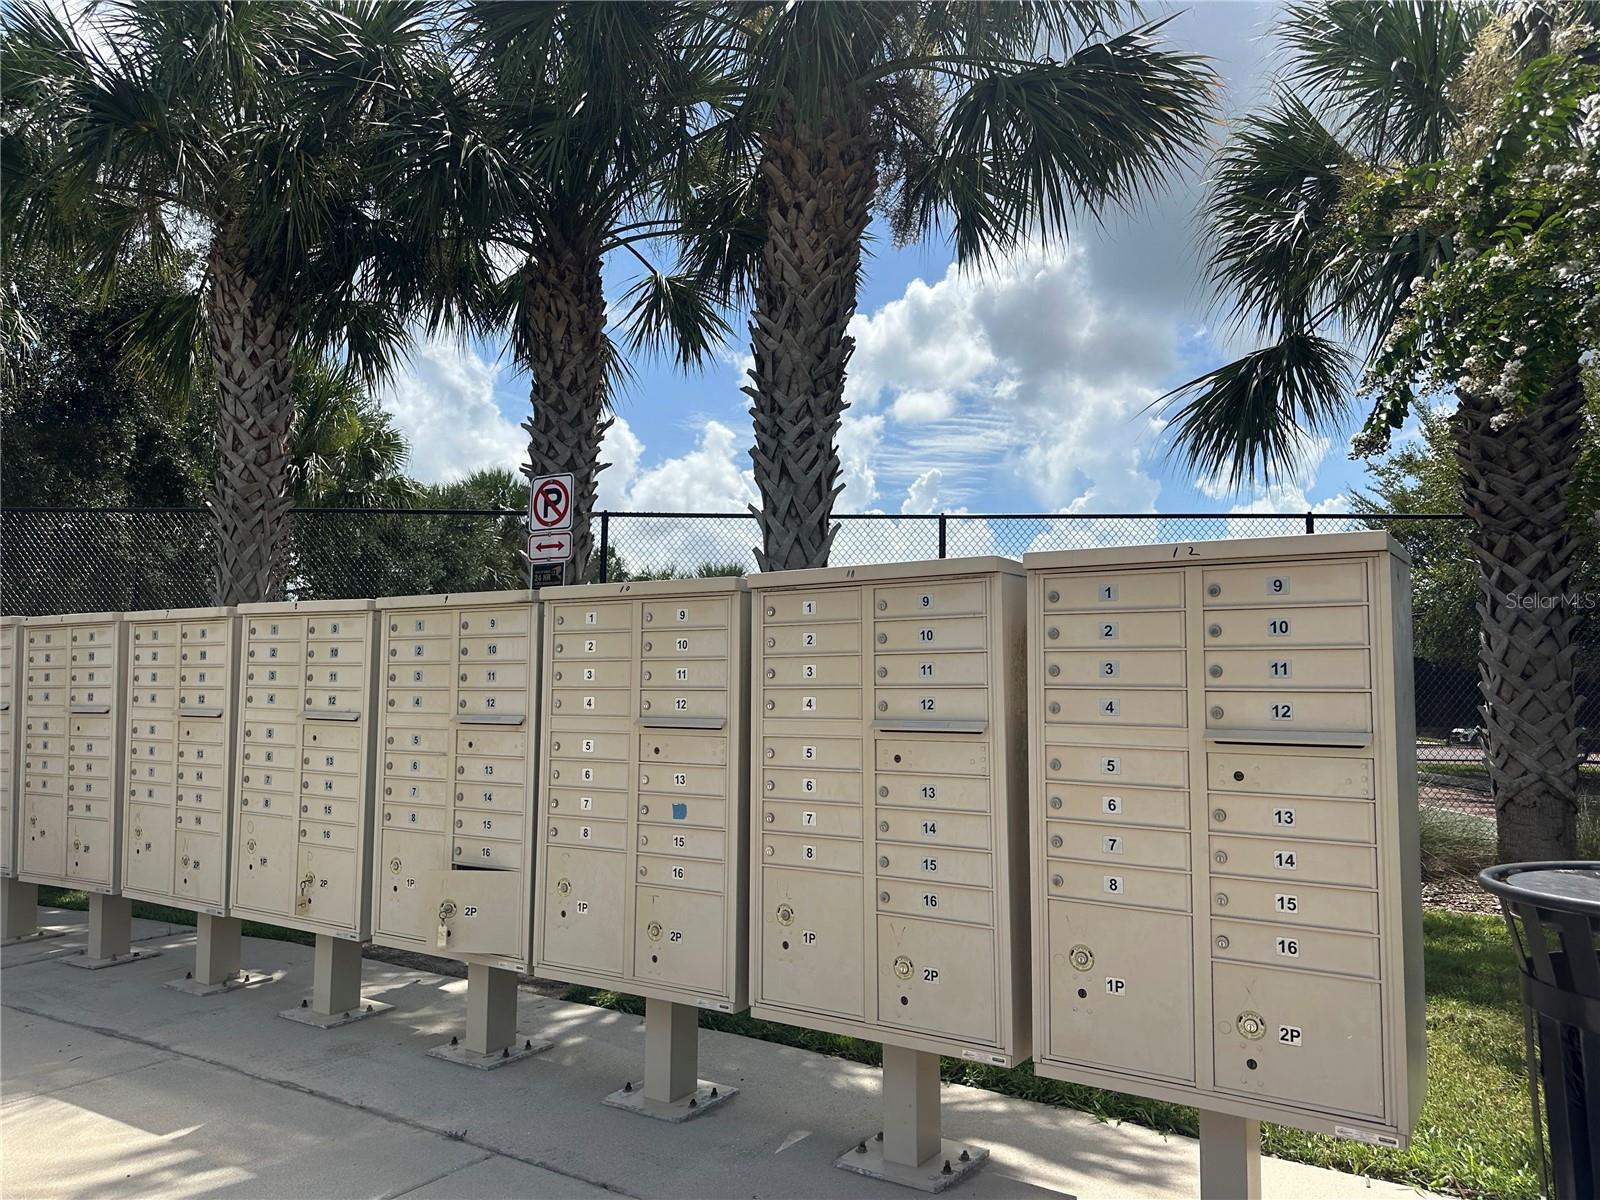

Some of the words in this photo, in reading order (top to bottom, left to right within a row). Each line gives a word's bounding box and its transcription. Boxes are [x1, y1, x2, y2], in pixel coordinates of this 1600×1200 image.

[1273, 579, 1283, 593] 9
[1104, 586, 1111, 599] 1
[922, 596, 930, 607] 9
[807, 602, 812, 613] 1
[589, 614, 594, 622] 1
[679, 610, 686, 620] 9
[1104, 624, 1113, 637] 2
[1269, 620, 1289, 634] 10
[806, 634, 813, 645] 2
[920, 630, 934, 641] 10
[488, 645, 497, 654] 10
[588, 642, 594, 651] 2
[677, 639, 688, 650] 10
[677, 669, 686, 679] 11
[806, 666, 813, 677] 3
[920, 664, 932, 676] 11
[1105, 662, 1114, 675] 3
[1271, 662, 1288, 676] 11
[487, 672, 495, 681] 11
[587, 670, 592, 680] 3
[486, 698, 495, 708] 12
[586, 698, 592, 707] 4
[676, 699, 687, 710] 12
[806, 698, 813, 709] 4
[920, 699, 934, 710] 12
[1105, 701, 1115, 714] 4
[1271, 704, 1291, 718] 12
[585, 741, 591, 751] 5
[806, 748, 813, 759] 5
[484, 766, 494, 775] 13
[1106, 759, 1116, 772] 5
[584, 770, 590, 780] 6
[675, 774, 686, 785] 13
[806, 780, 813, 792] 6
[484, 792, 492, 802] 14
[922, 786, 936, 799] 13
[584, 799, 589, 808] 7
[1107, 798, 1117, 812] 6
[806, 813, 813, 824] 7
[1274, 810, 1294, 825] 13
[483, 820, 492, 830] 15
[922, 822, 936, 834] 14
[583, 828, 589, 838] 8
[674, 836, 685, 848] 15
[1108, 838, 1117, 851] 7
[482, 848, 491, 857] 16
[806, 847, 813, 859] 8
[923, 858, 937, 871] 15
[1275, 853, 1296, 868] 14
[672, 868, 684, 879] 16
[406, 878, 415, 887] 1P
[1109, 878, 1118, 892] 8
[923, 894, 938, 907] 16
[1277, 896, 1297, 911] 15
[464, 906, 477, 917] 2P
[578, 902, 588, 912] 1P
[670, 931, 682, 942] 2P
[803, 932, 816, 944] 1P
[1278, 939, 1298, 955] 16
[924, 968, 939, 982] 2P
[1107, 979, 1125, 993] 1P
[1280, 1027, 1301, 1043] 2P
